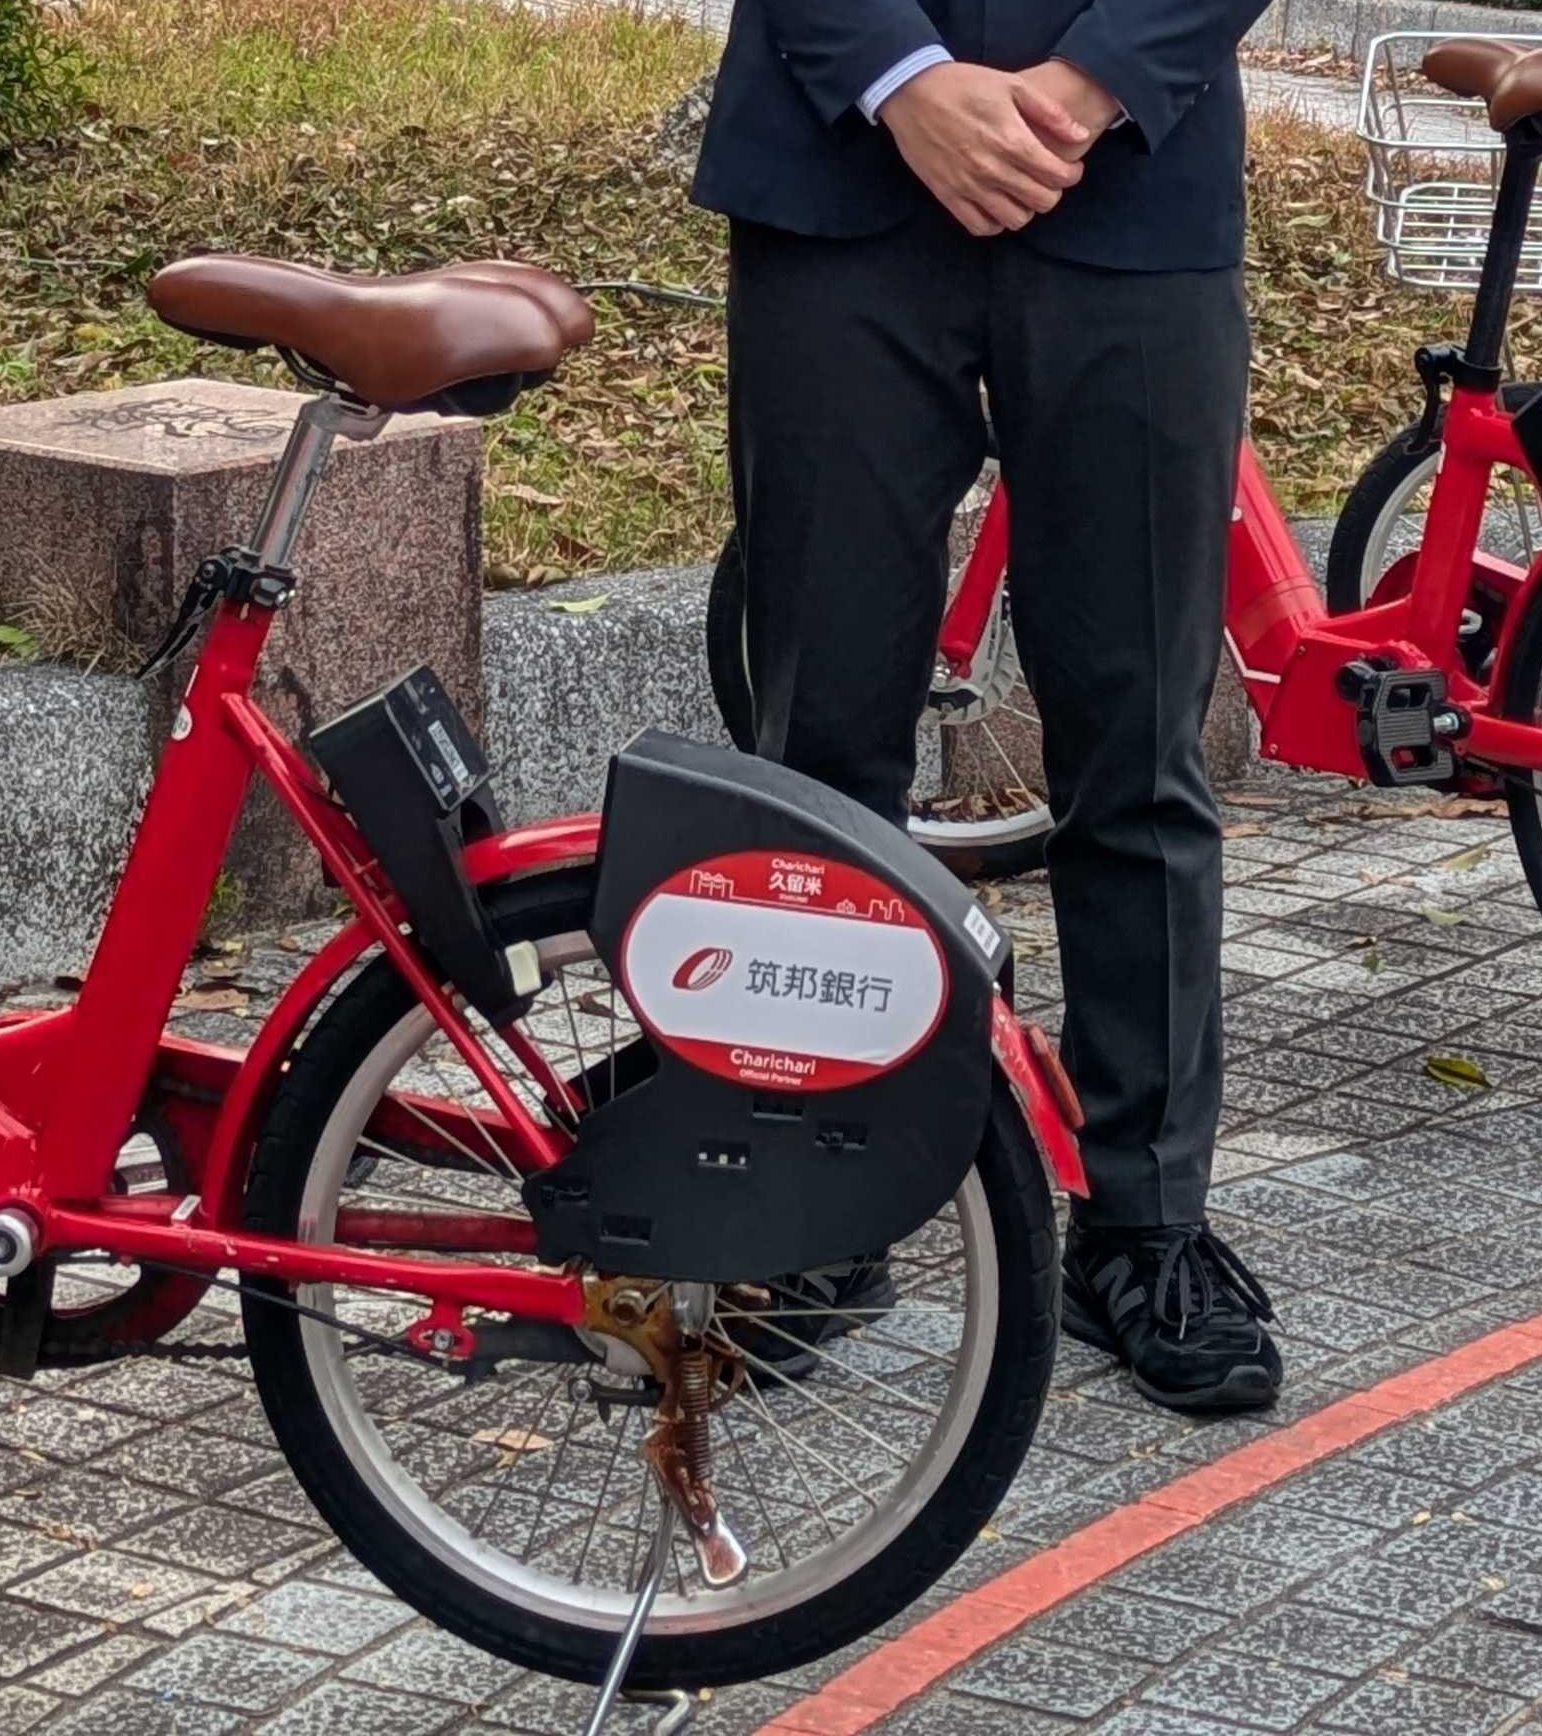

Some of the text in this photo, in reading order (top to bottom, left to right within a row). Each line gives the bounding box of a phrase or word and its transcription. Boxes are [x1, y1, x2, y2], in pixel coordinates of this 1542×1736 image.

[768, 871, 823, 896] 久留米
[745, 958, 894, 1013] 筑邦銀行
[730, 1048, 817, 1076] Charichari
